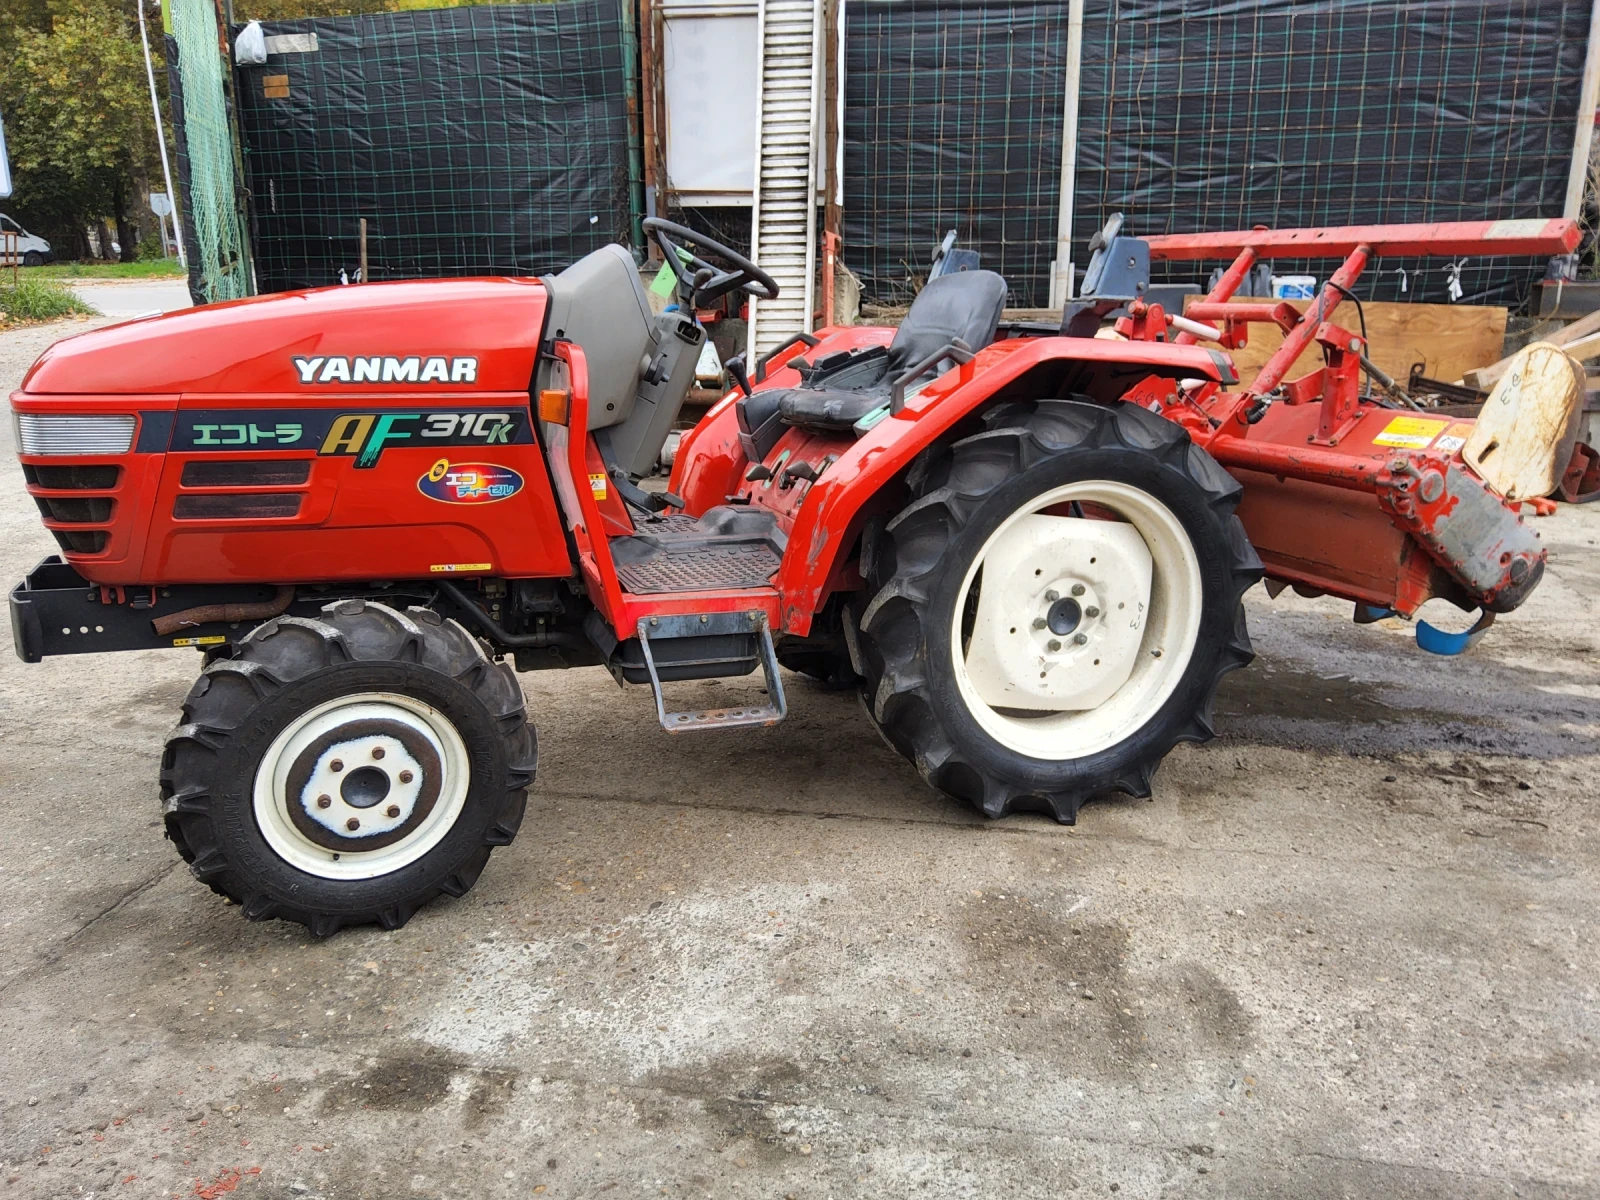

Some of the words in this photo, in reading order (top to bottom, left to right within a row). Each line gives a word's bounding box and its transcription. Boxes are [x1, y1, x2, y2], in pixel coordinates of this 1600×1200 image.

[293, 356, 478, 383] YANMAR
[193, 423, 302, 445] エコトラ
[446, 473, 477, 486] エコ
[457, 484, 514, 498] ディーゼル
